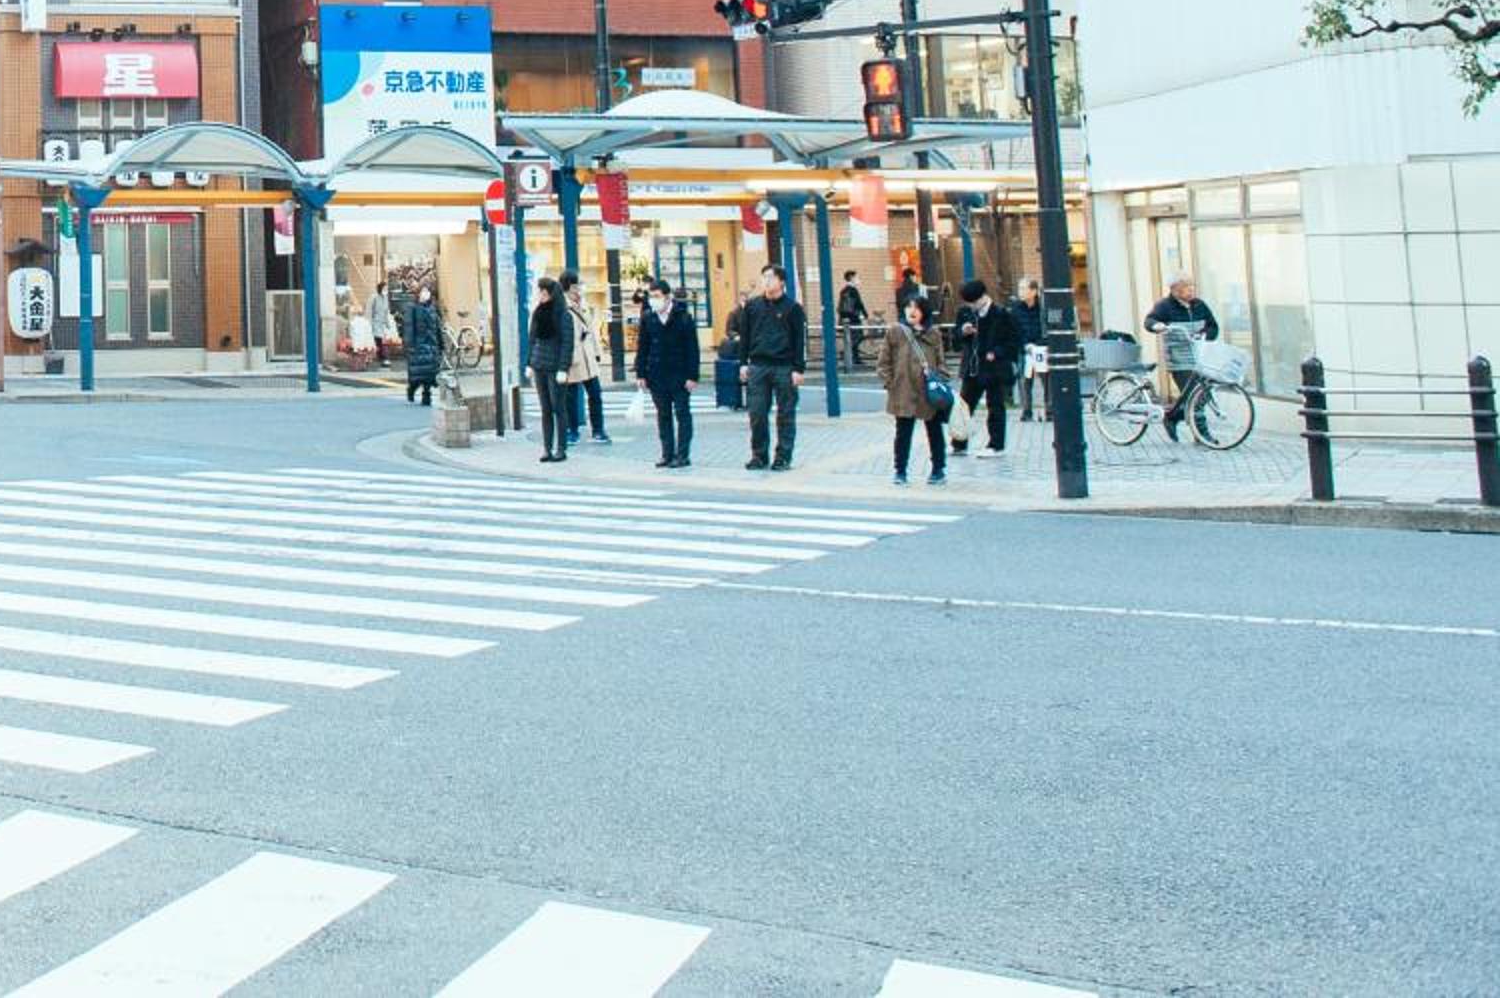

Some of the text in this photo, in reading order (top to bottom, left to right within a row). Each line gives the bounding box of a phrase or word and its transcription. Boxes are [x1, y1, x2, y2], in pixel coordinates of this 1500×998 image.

[103, 53, 159, 95] 星
[384, 69, 486, 94] 京急不動産
[29, 285, 46, 332] 大金星
